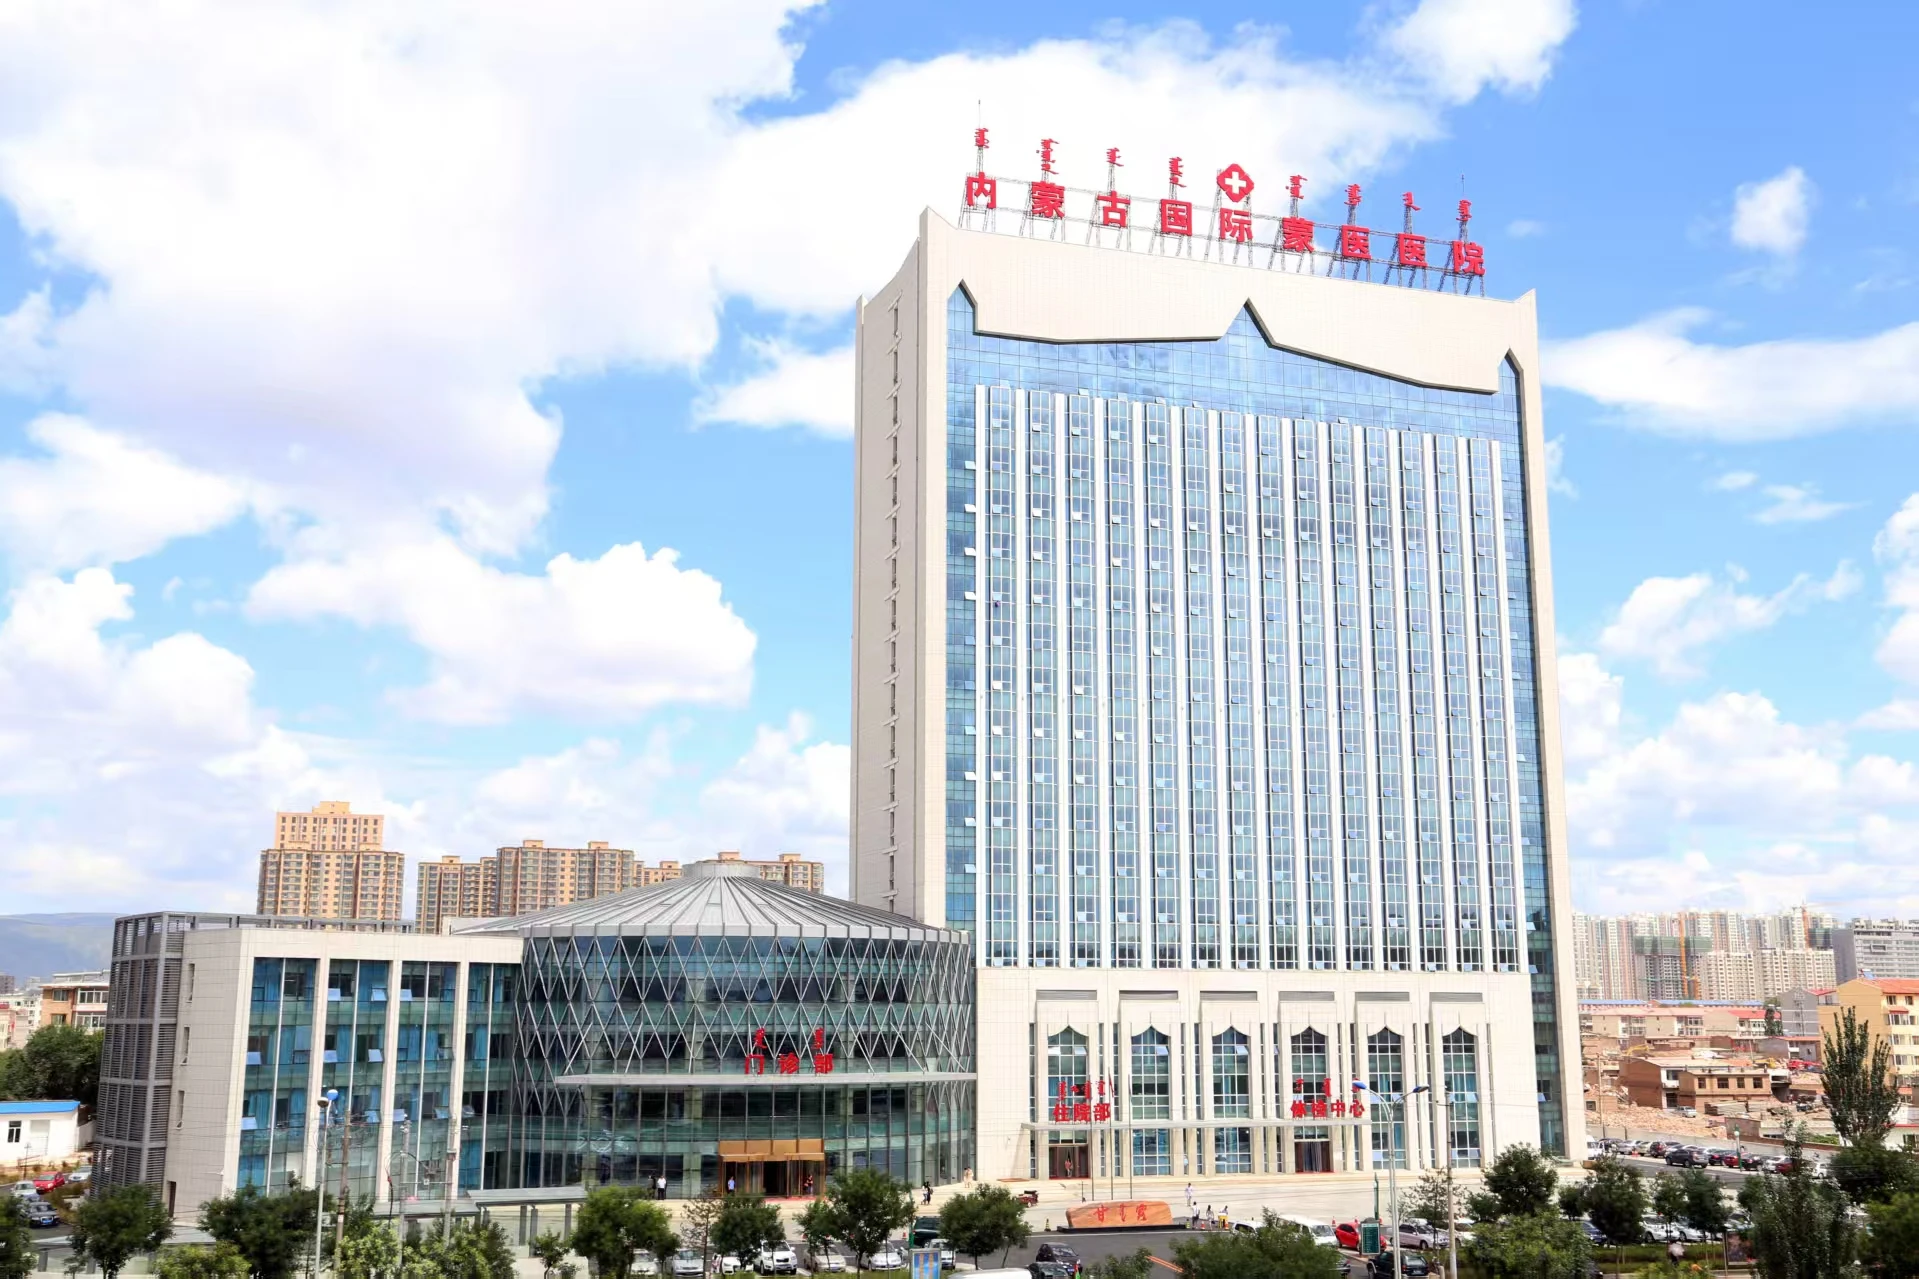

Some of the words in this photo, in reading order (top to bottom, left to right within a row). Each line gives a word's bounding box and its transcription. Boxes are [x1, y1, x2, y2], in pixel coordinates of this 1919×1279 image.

[966, 172, 1486, 276] 内蒙古国际蒙医医院
[744, 1053, 834, 1075] 门诊部
[1053, 1103, 1111, 1122] 住院部
